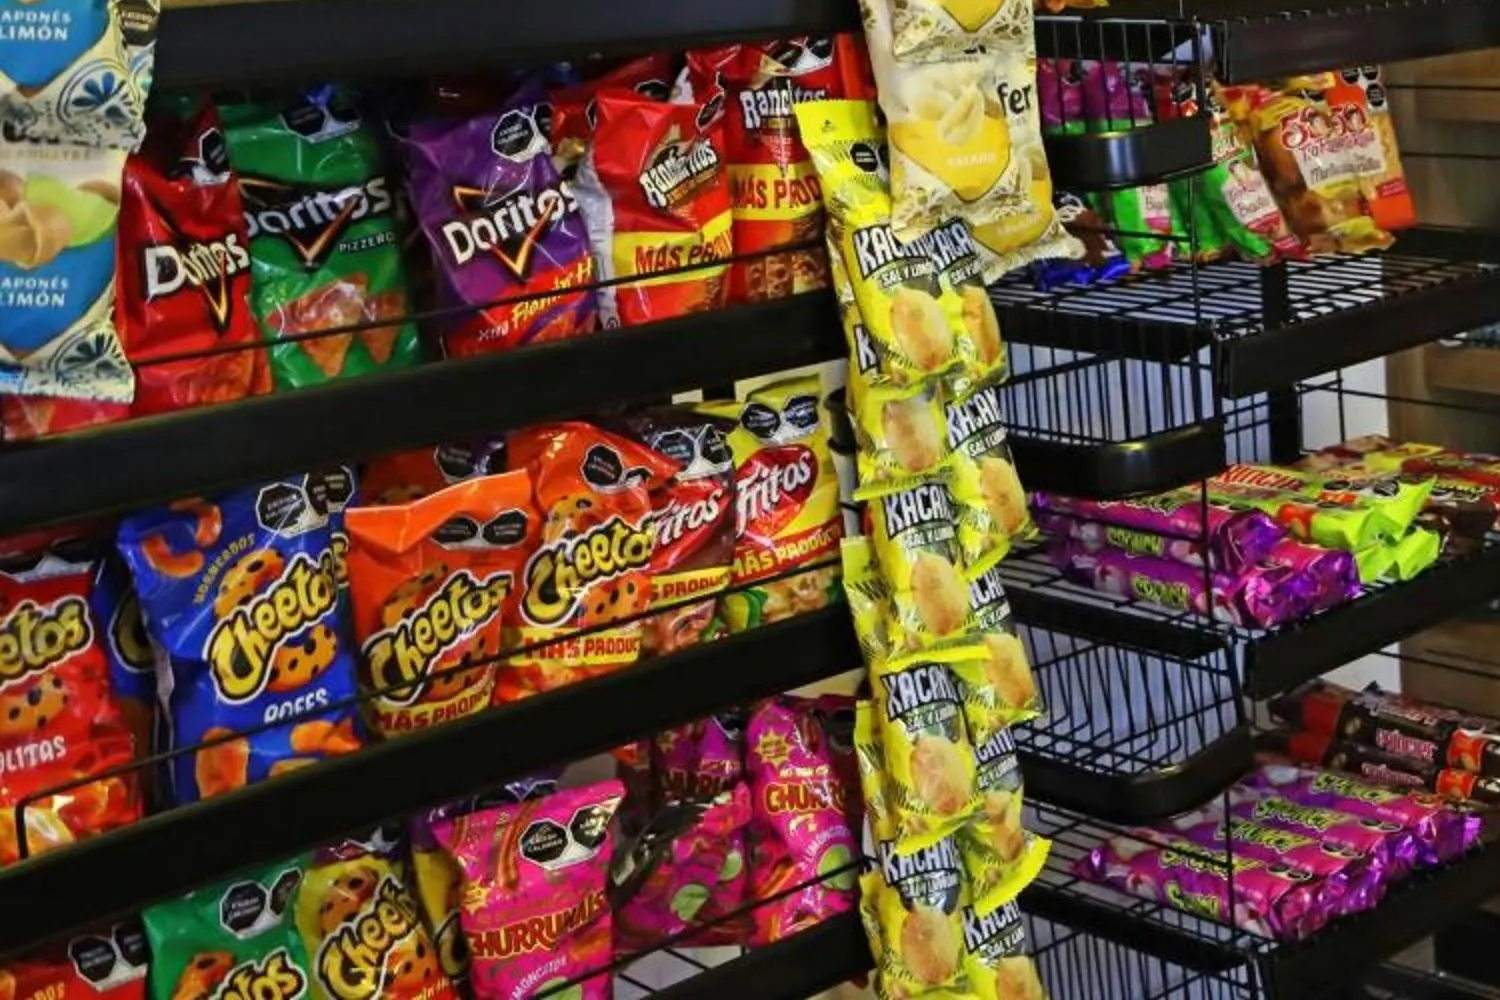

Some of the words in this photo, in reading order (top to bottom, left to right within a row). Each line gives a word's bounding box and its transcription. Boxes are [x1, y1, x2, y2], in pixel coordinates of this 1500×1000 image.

[2, 8, 72, 24] APONÉS
[338, 230, 397, 253] PIZZERO
[443, 182, 580, 266] Doritos
[2, 276, 69, 291] APONÉS
[736, 450, 813, 535] Fritos
[524, 517, 652, 621] Cheeto
[366, 573, 513, 699] Cheetos
